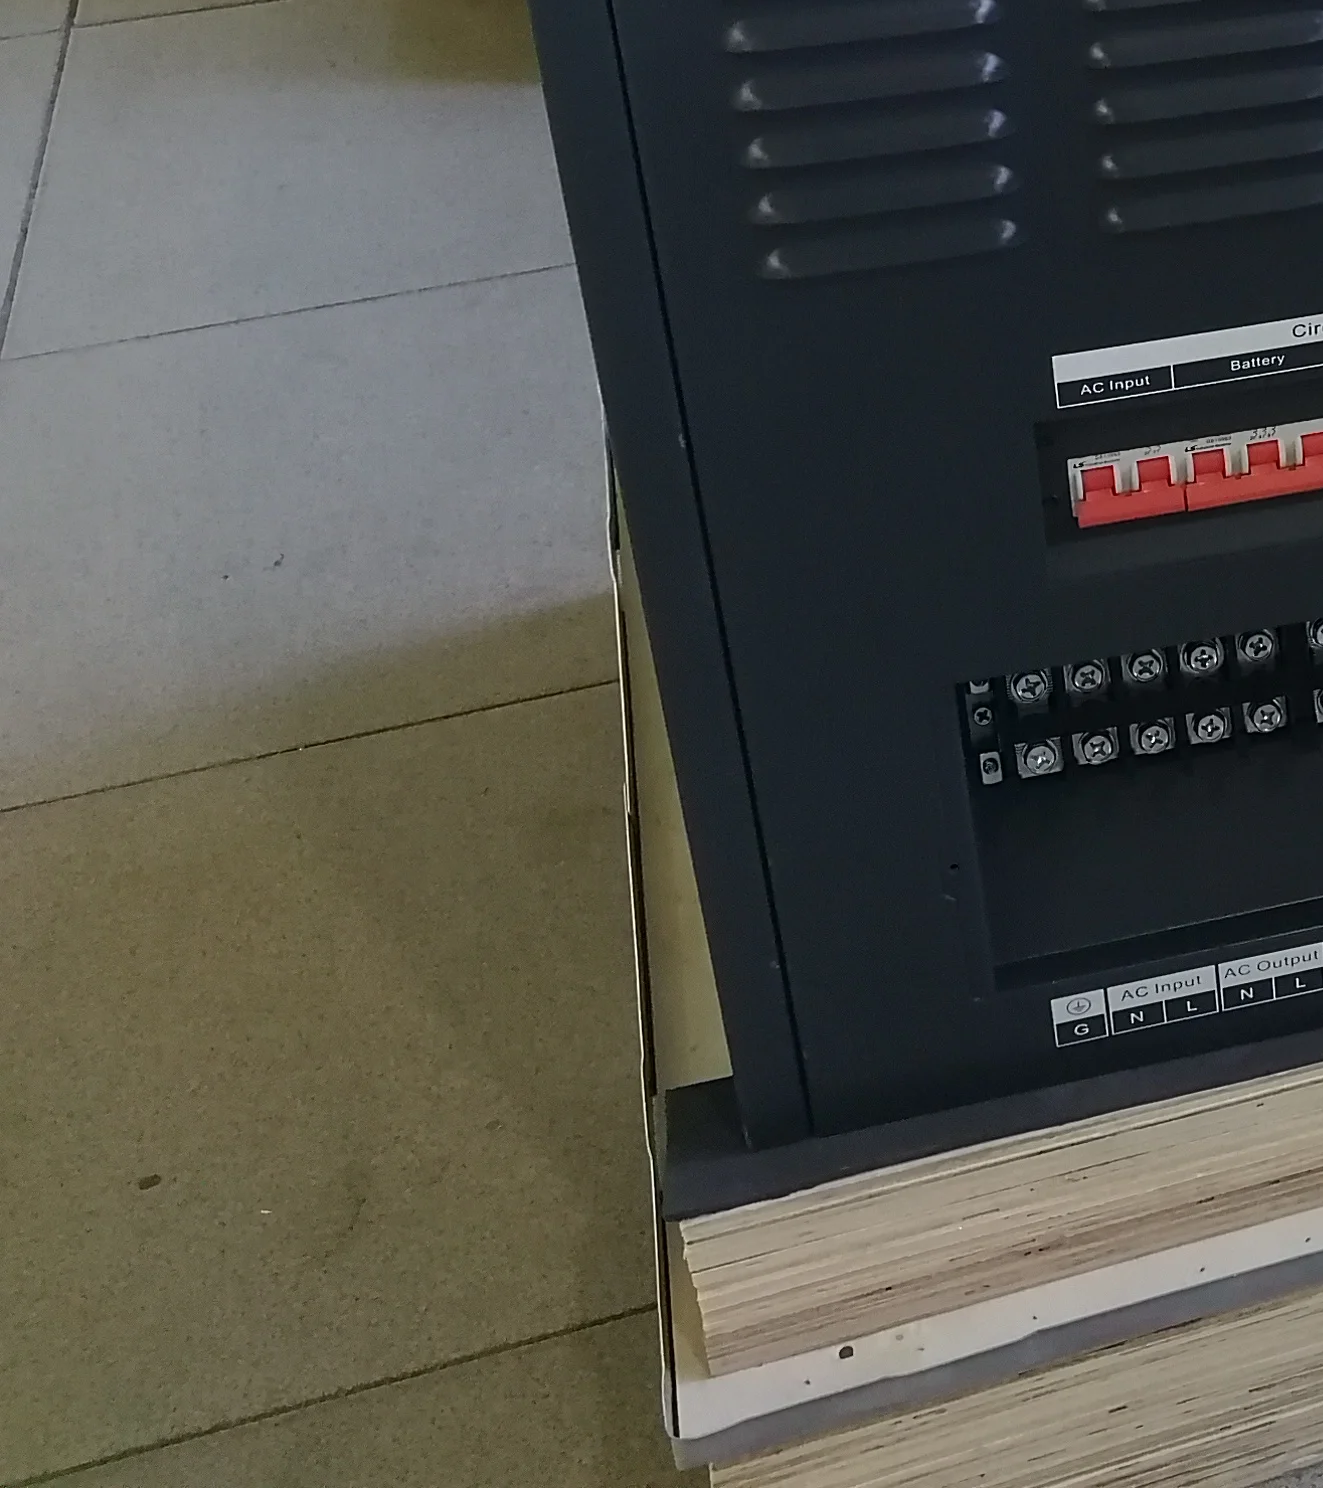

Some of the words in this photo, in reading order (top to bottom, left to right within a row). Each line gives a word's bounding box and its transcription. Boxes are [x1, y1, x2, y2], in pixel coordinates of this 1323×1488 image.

[1230, 353, 1285, 372] Battery
[1080, 382, 1104, 396] AC
[1109, 374, 1151, 395] Input
[1224, 961, 1253, 979] AC
[1257, 949, 1320, 972] Output
[1120, 985, 1150, 1001] AC
[1155, 975, 1203, 995] Input
[1073, 1022, 1090, 1036] G
[1130, 1010, 1144, 1024] N
[1186, 999, 1198, 1012] L
[1240, 987, 1254, 1000] N
[1294, 976, 1306, 989] L
